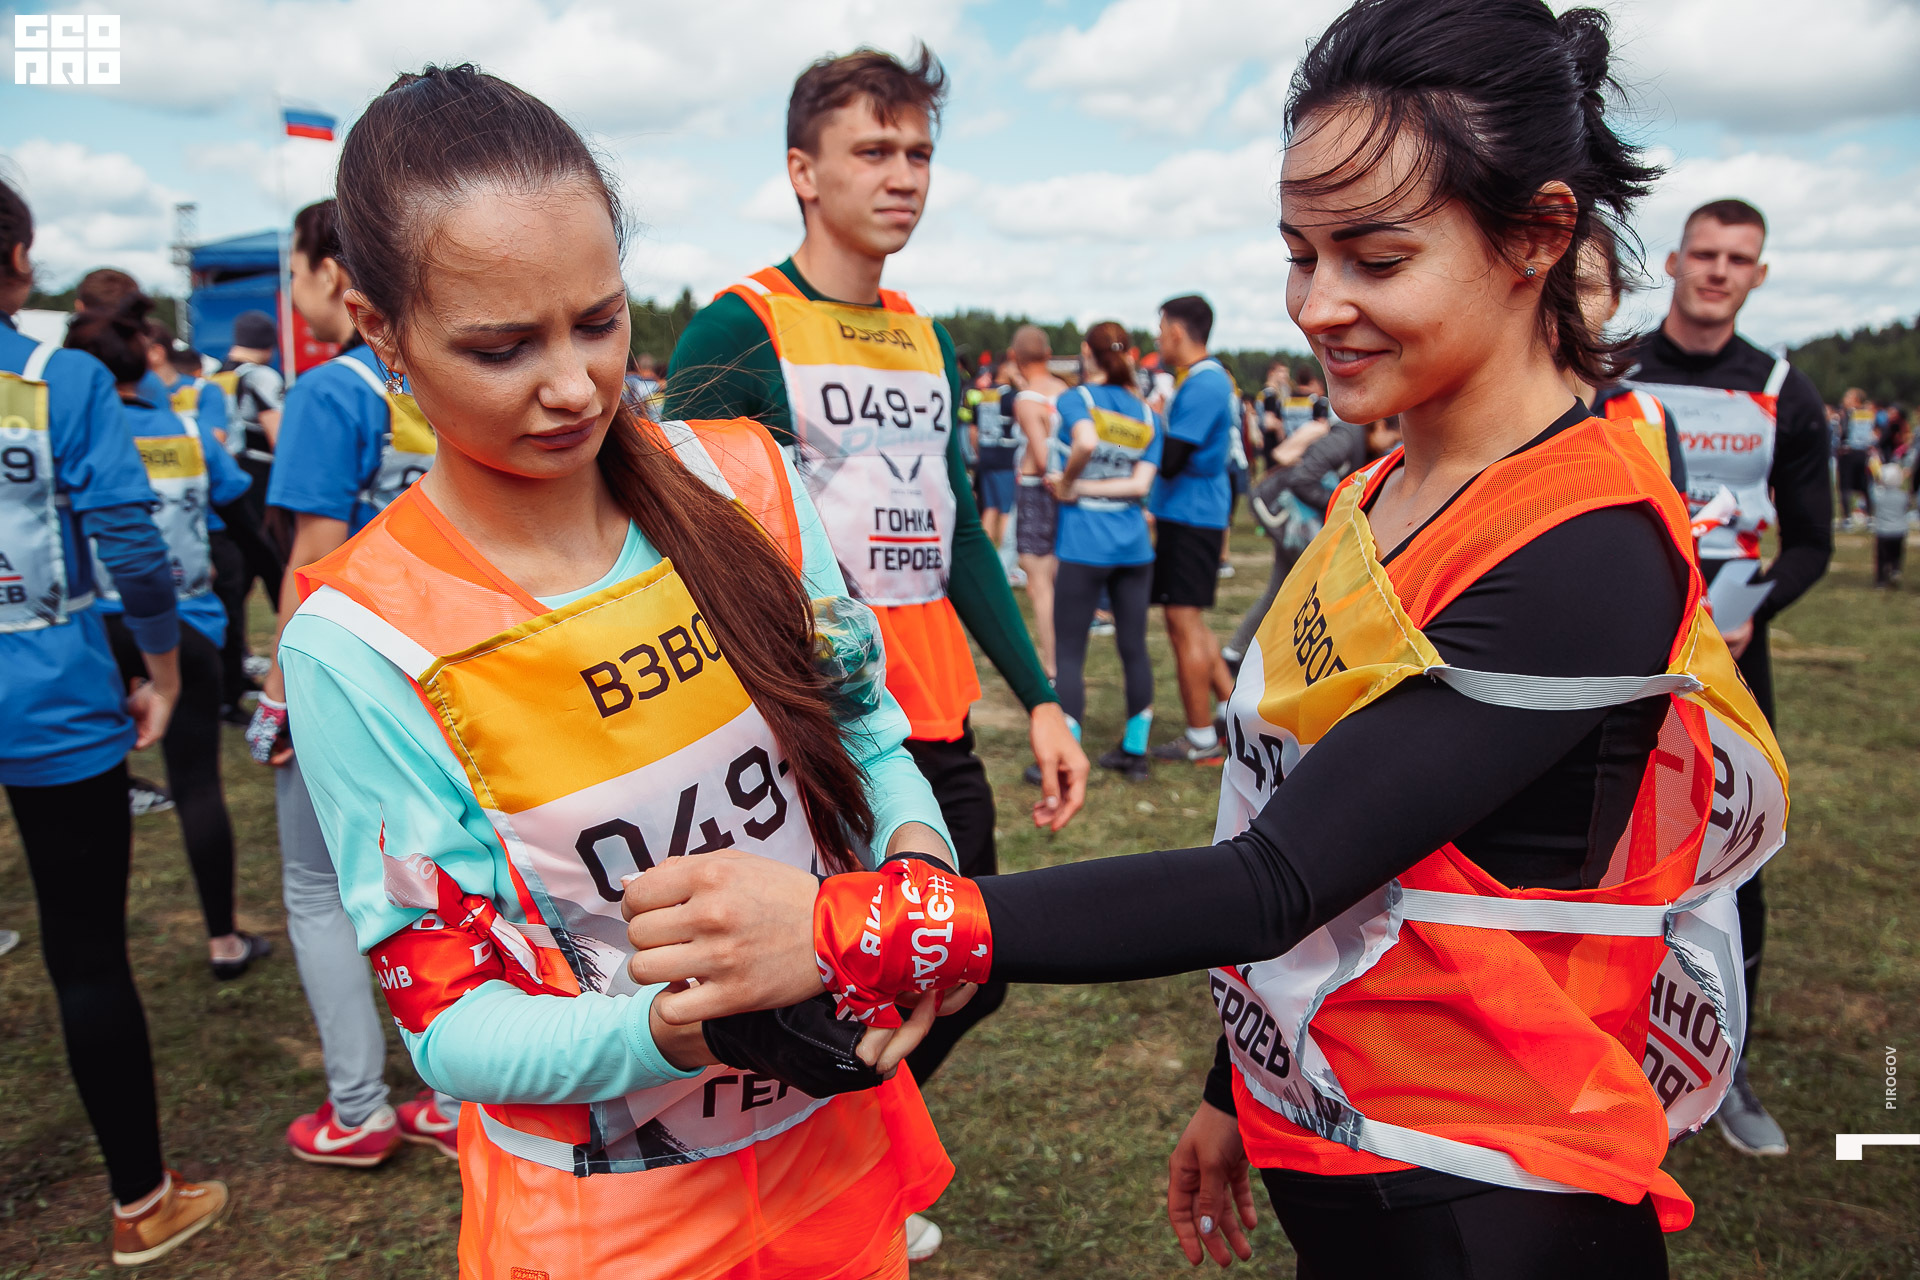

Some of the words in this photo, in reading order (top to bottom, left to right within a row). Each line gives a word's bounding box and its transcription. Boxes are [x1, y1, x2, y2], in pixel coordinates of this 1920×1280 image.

[821, 383, 946, 432] 049-2
[874, 507, 936, 532] ГОНКА
[579, 611, 722, 719] ВЗВО
